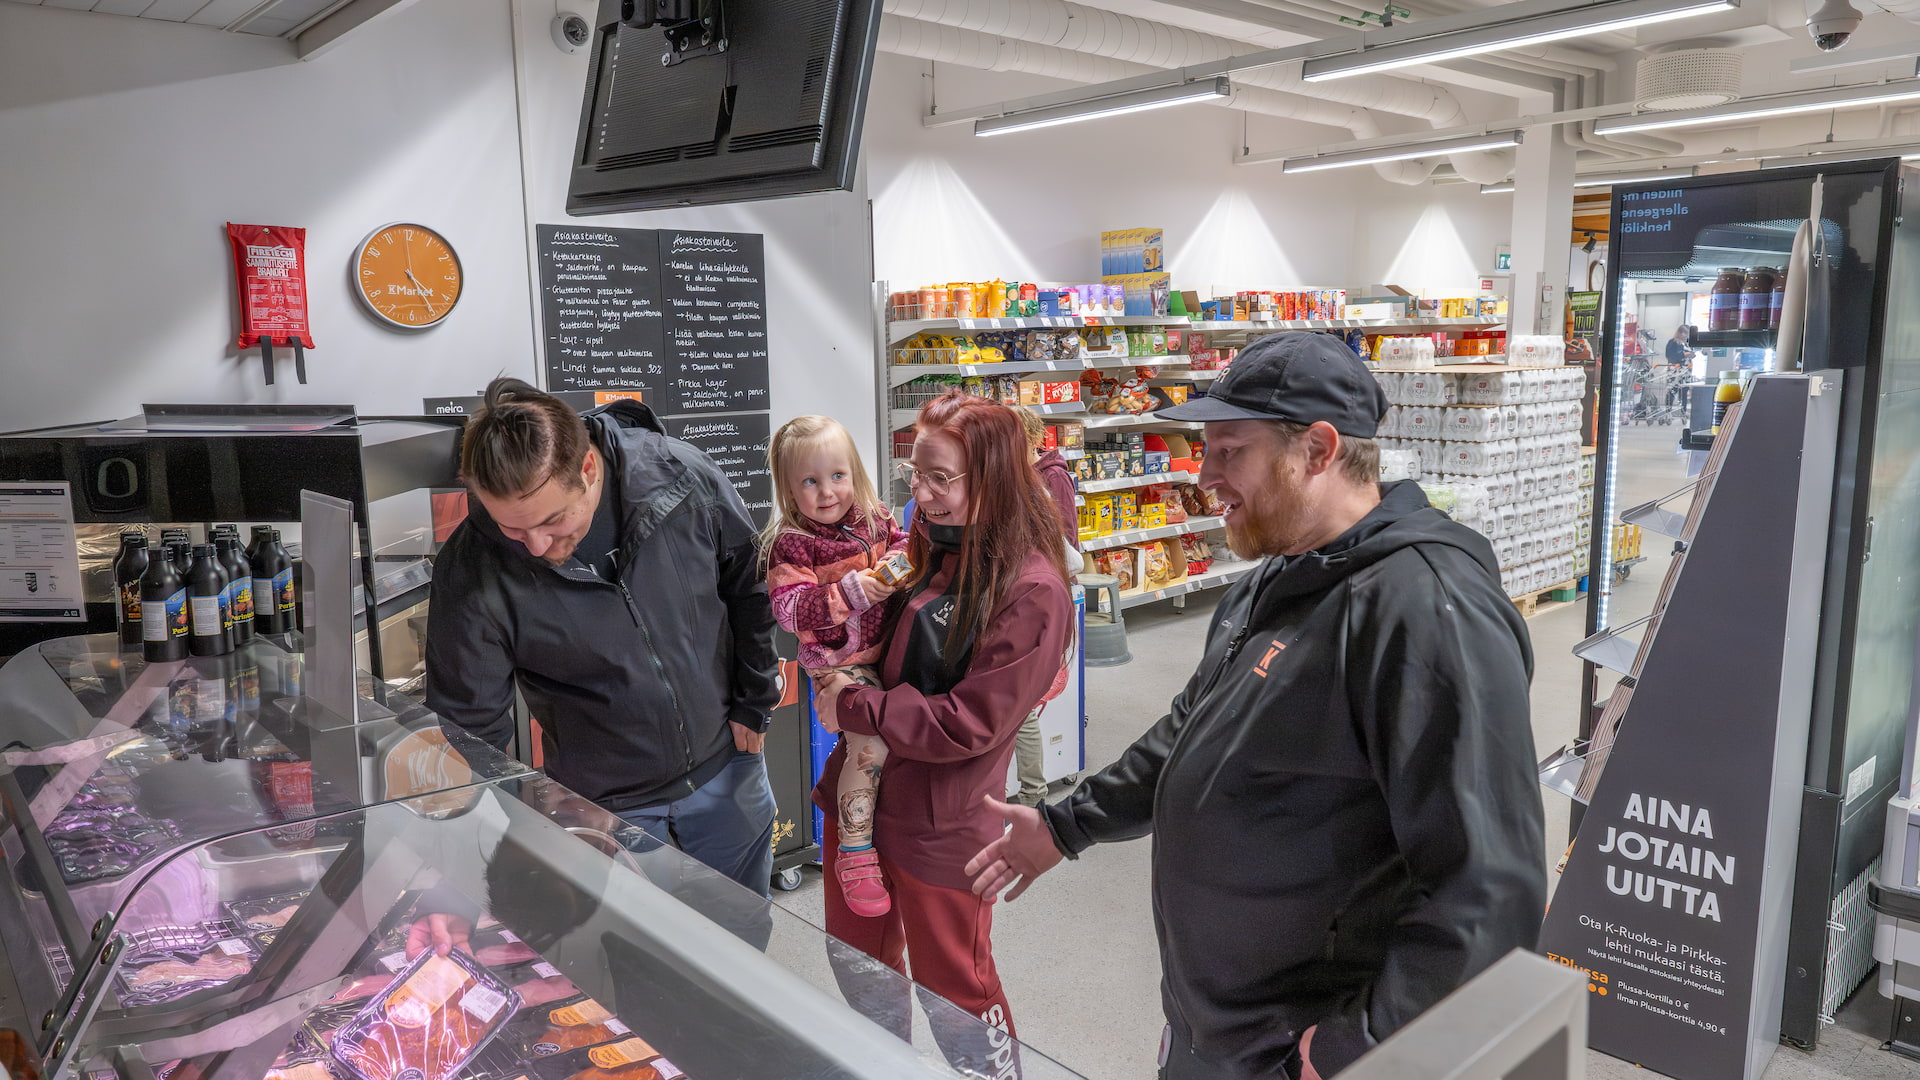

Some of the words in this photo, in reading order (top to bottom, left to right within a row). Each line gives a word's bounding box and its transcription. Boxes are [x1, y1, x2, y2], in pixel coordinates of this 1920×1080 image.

[382, 232, 393, 245] 11
[404, 229, 413, 241] 12
[426, 236, 433, 247] 1
[250, 248, 294, 259] FIRETECH
[368, 246, 381, 258] 10
[438, 253, 449, 262] 2
[622, 263, 648, 274] kaupan
[370, 289, 381, 298] 8
[440, 292, 451, 302] 4
[388, 303, 396, 314] 7
[409, 310, 415, 321] 6
[560, 320, 593, 330] tuotteiden
[596, 319, 620, 332] hyllystä
[586, 335, 604, 347] sipsit
[572, 349, 587, 357] ovat
[590, 349, 614, 359] kaupan
[561, 360, 587, 373] Lindt
[592, 364, 616, 373] tumma
[576, 376, 602, 387] tilattu
[677, 378, 703, 389] Pirkka
[734, 390, 744, 398] on
[436, 401, 464, 414] meira
[1624, 793, 1713, 839] AINA
[1598, 827, 1735, 885] JOTAIN
[1607, 865, 1721, 923] UUTTA
[1579, 914, 1602, 931] Ota
[1605, 922, 1663, 948] K-Ruoka-
[1665, 940, 1677, 954] ja
[1681, 944, 1727, 966] Pirkka-
[1605, 937, 1631, 955] lehti
[1635, 950, 1686, 971] mukaasi
[1690, 963, 1726, 984] tästä.
[1587, 947, 1607, 960] Näytä
[1607, 954, 1622, 964] lehti
[1623, 959, 1649, 972] kassalla
[1649, 968, 1682, 983] ostoksiesi
[1682, 979, 1725, 997] yhteydessä!
[1618, 981, 1673, 1006] Plussa-kortilla
[1675, 1000, 1682, 1008] 0
[1683, 1003, 1690, 1011] €
[1617, 993, 1639, 1007] Ilman
[1640, 1003, 1695, 1026] Plussa-korttia
[1697, 1022, 1717, 1033] 4,90
[1720, 1028, 1727, 1036] €
